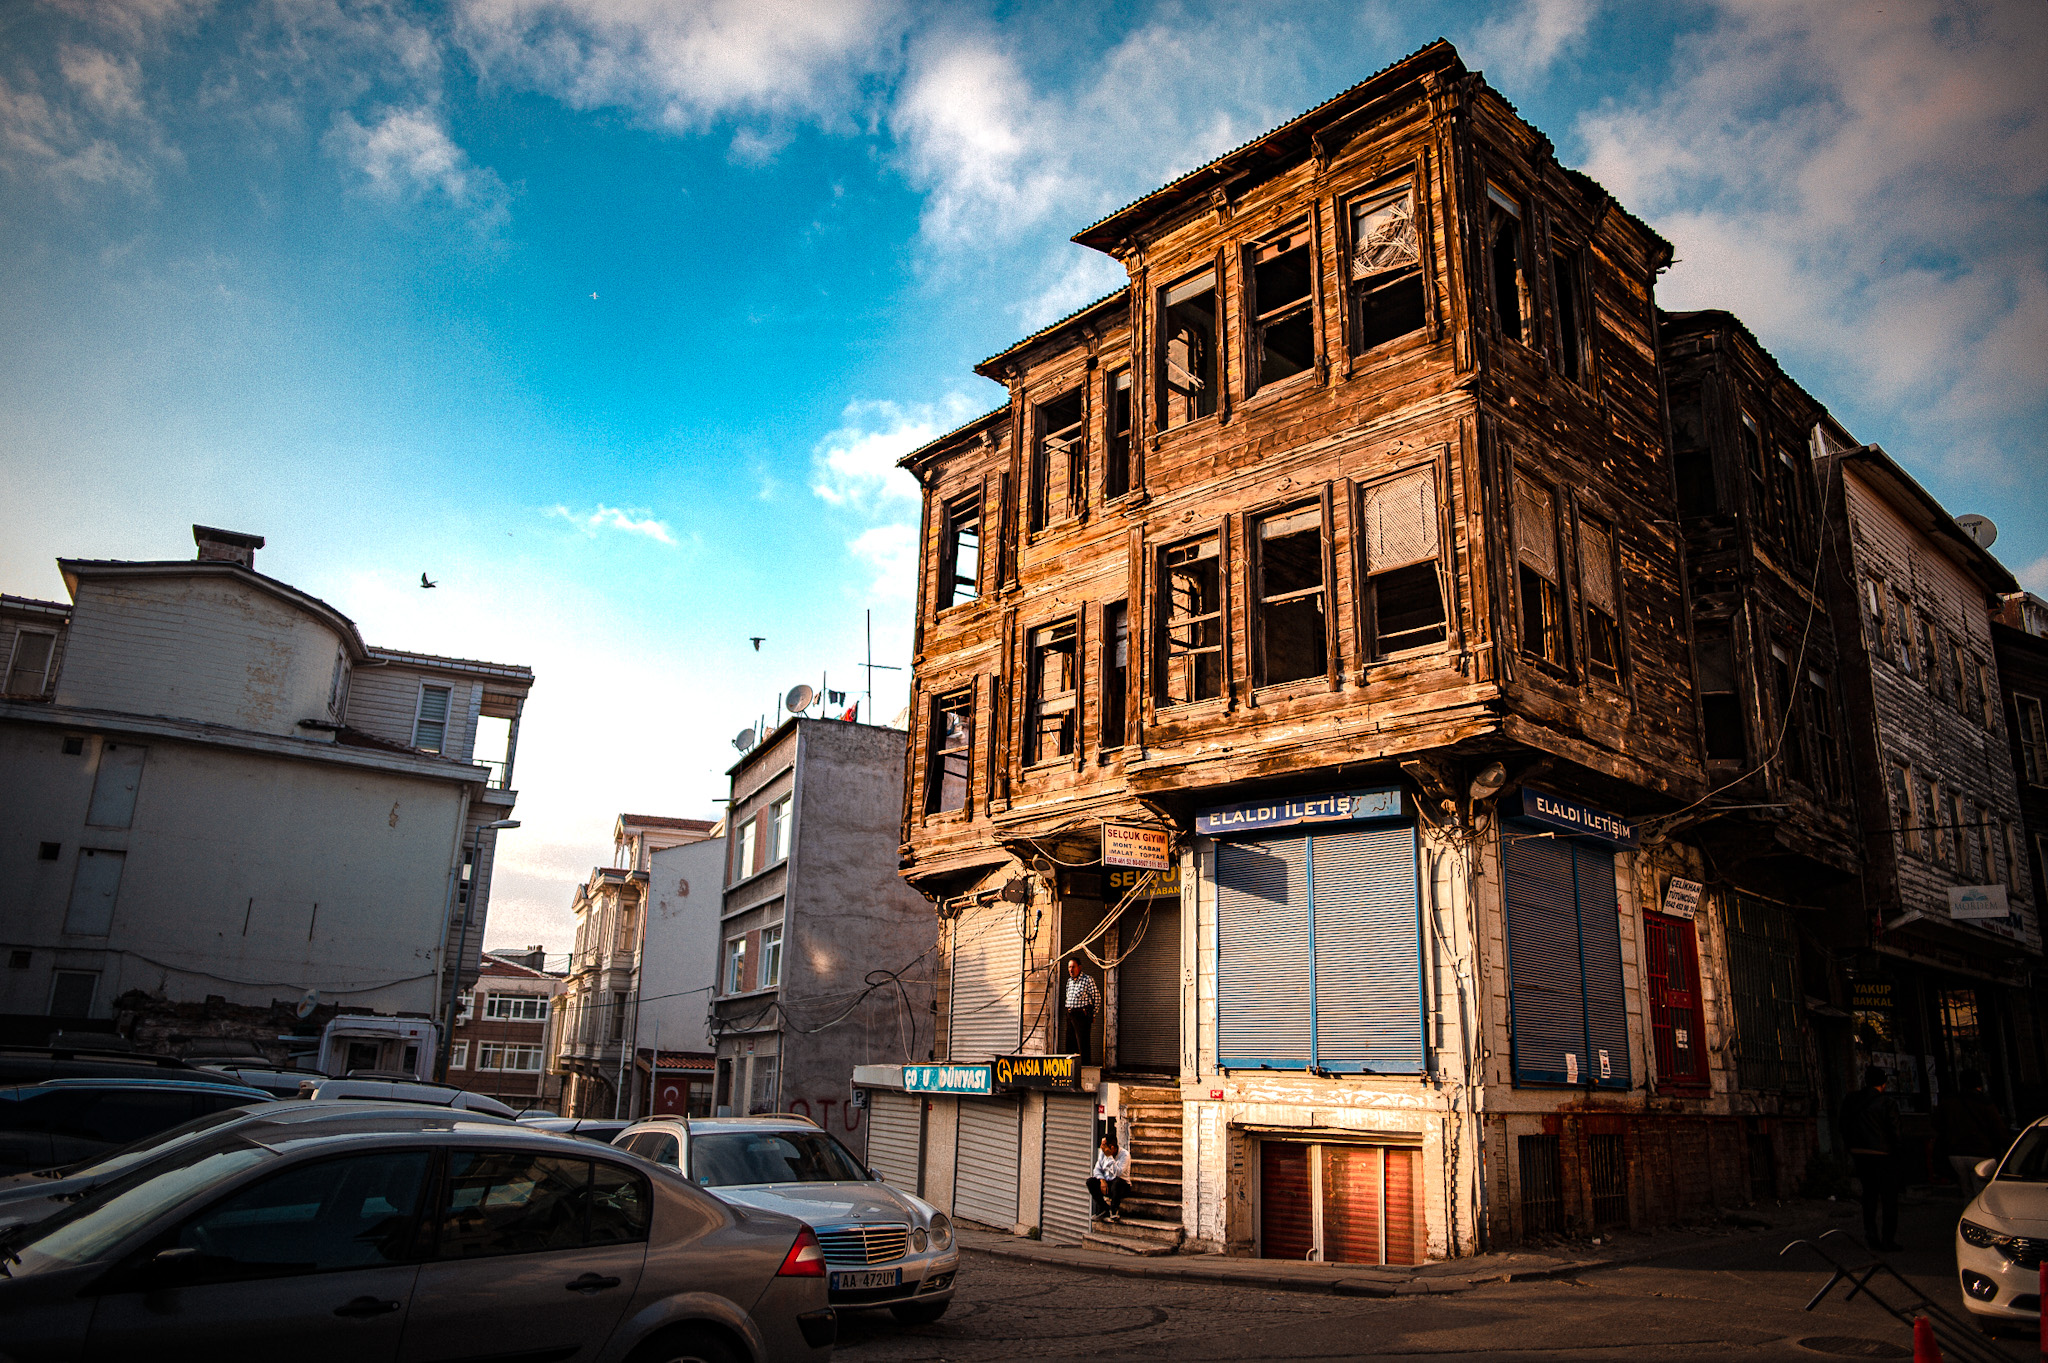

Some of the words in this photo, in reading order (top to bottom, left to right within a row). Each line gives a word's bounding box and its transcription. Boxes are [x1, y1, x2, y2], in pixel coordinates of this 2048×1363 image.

[1210, 806, 1277, 826] ELALDI
[1536, 797, 1580, 823] ELALDI
[1583, 808, 1630, 839] İLETİŞİM
[1107, 828, 1140, 842] SELÇUK
[1112, 841, 1132, 849] MONT
[1140, 852, 1165, 860] TOPTAN
[1109, 866, 1181, 887] SELU
[1852, 983, 1892, 994] YAKUP
[1852, 996, 1894, 1007] BAKKAL
[1042, 1058, 1073, 1077] MONT
[939, 1066, 987, 1089] DÜNYASI
[843, 1274, 856, 1287] AA
